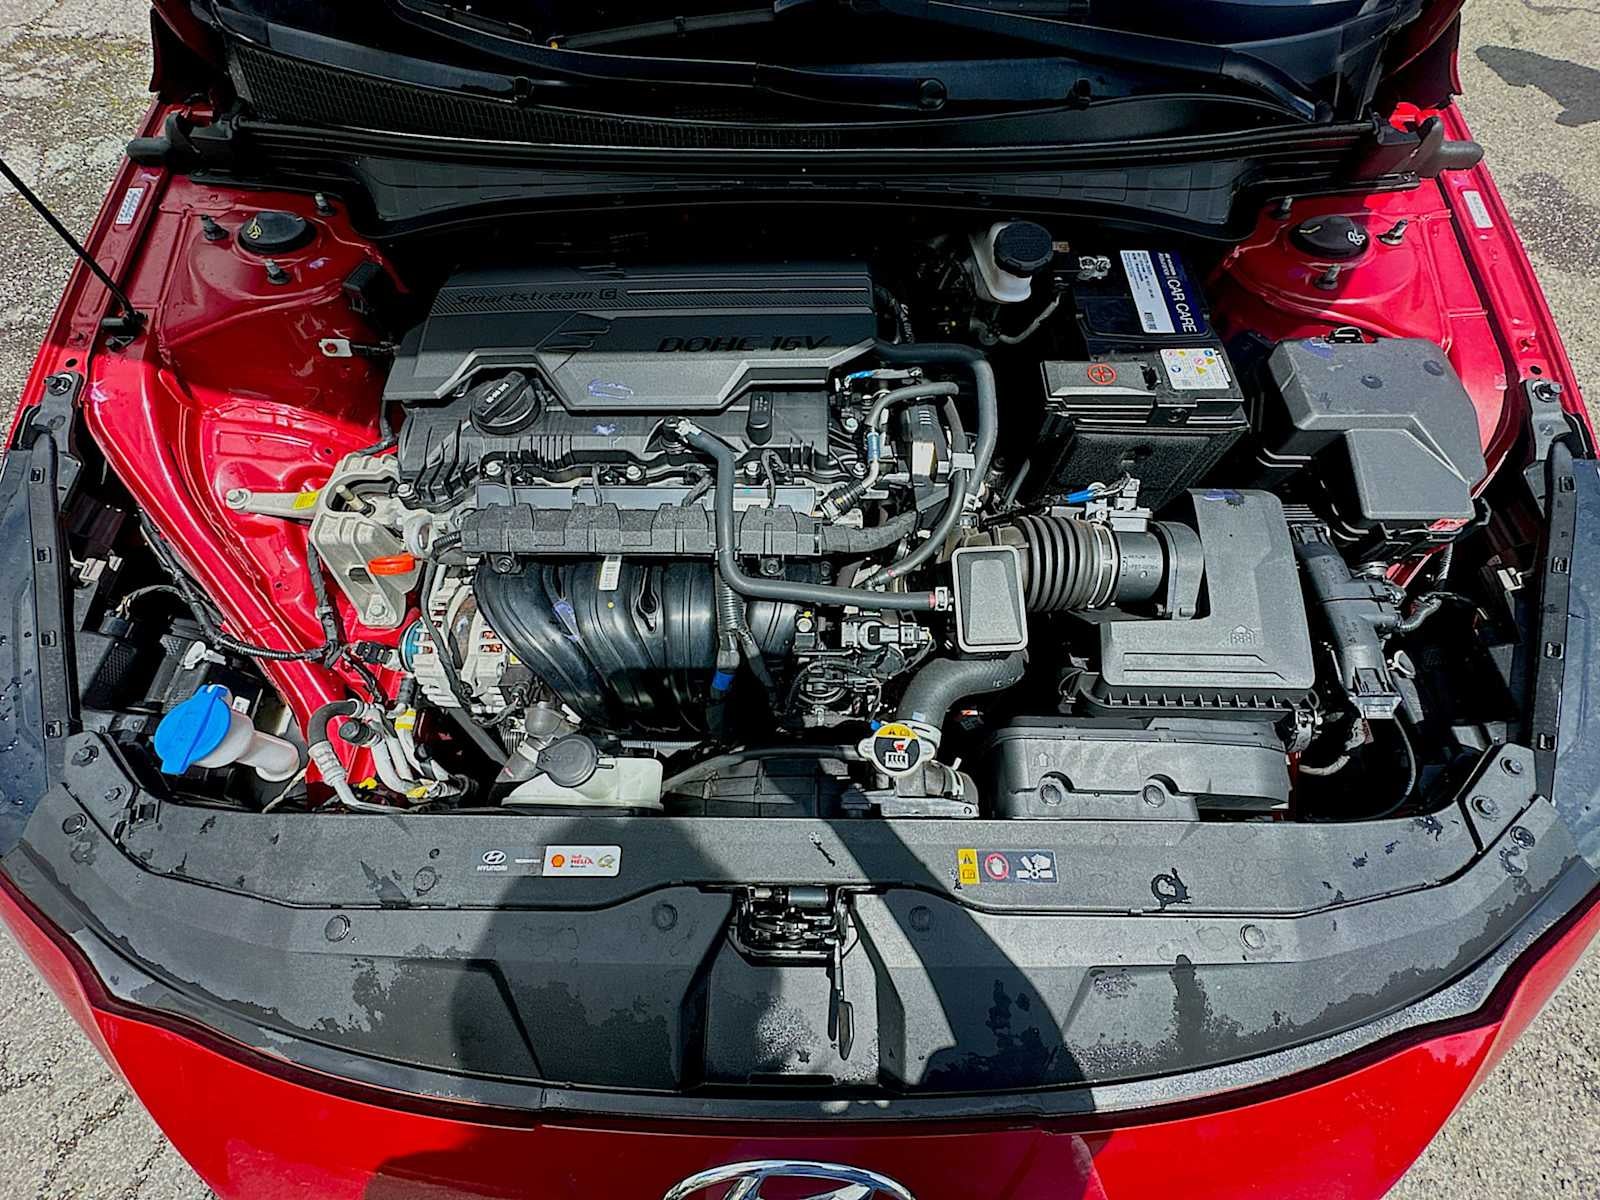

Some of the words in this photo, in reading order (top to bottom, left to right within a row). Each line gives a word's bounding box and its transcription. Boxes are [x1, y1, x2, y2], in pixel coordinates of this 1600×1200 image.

[1167, 279, 1185, 301] CAR
[1175, 303, 1198, 333] CARE
[657, 336, 757, 352] DOHC
[769, 336, 832, 351] 16V
